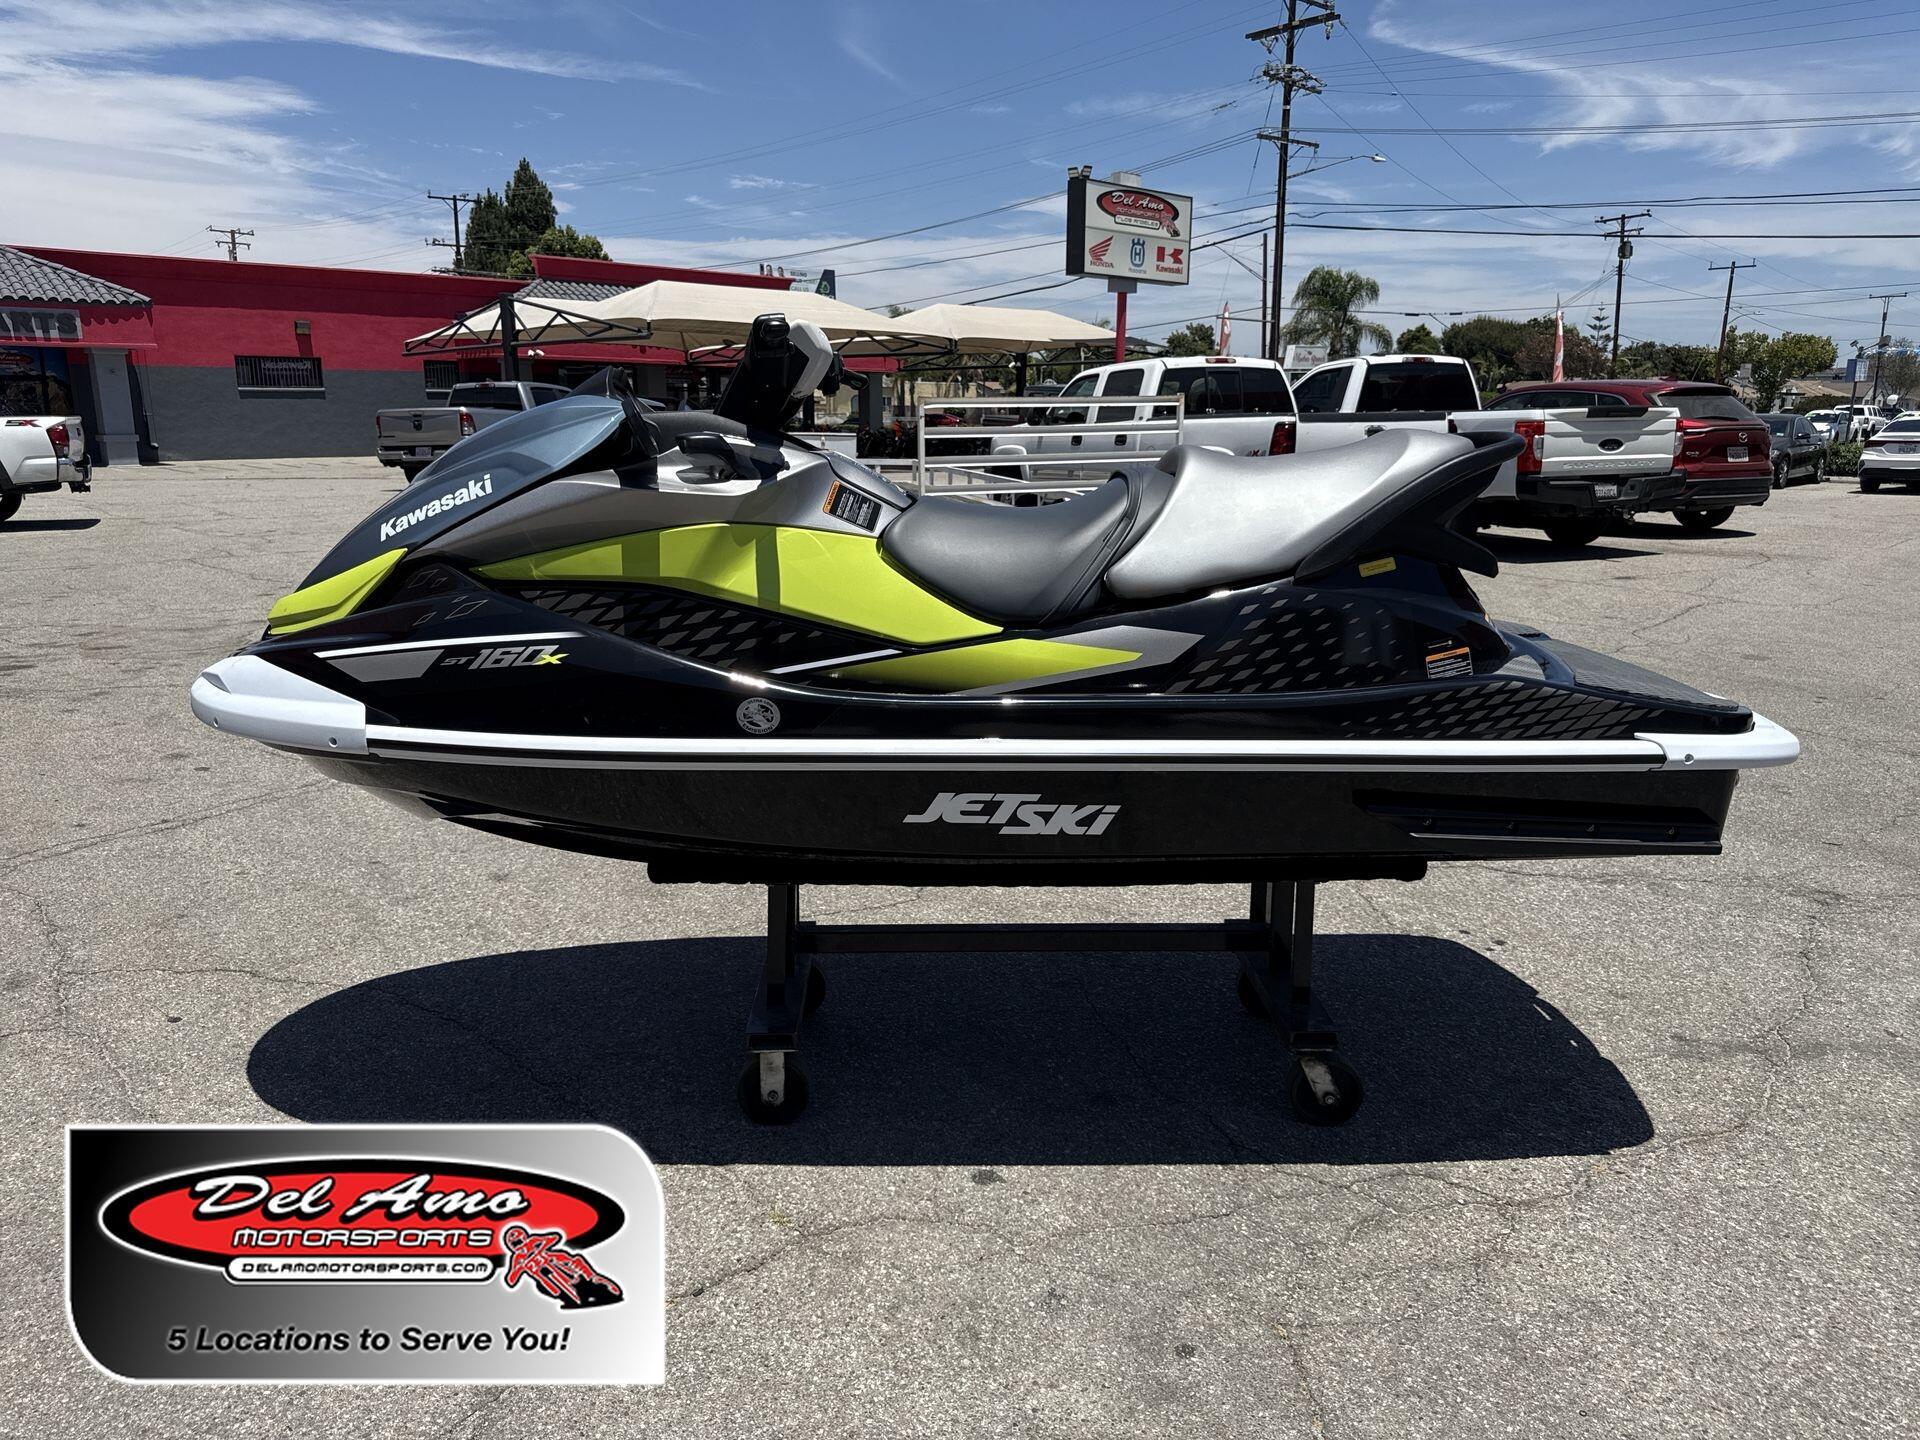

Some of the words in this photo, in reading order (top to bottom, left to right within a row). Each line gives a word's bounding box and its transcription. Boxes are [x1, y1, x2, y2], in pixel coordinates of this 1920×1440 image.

[1111, 191, 1135, 206] Del
[1136, 197, 1164, 211] Amo
[1089, 260, 1115, 269] HONDA
[1155, 264, 1184, 275] Kawasaki
[1562, 461, 1616, 470] SUPER
[1618, 459, 1656, 468] DUTY
[380, 473, 493, 542] Kawasaki
